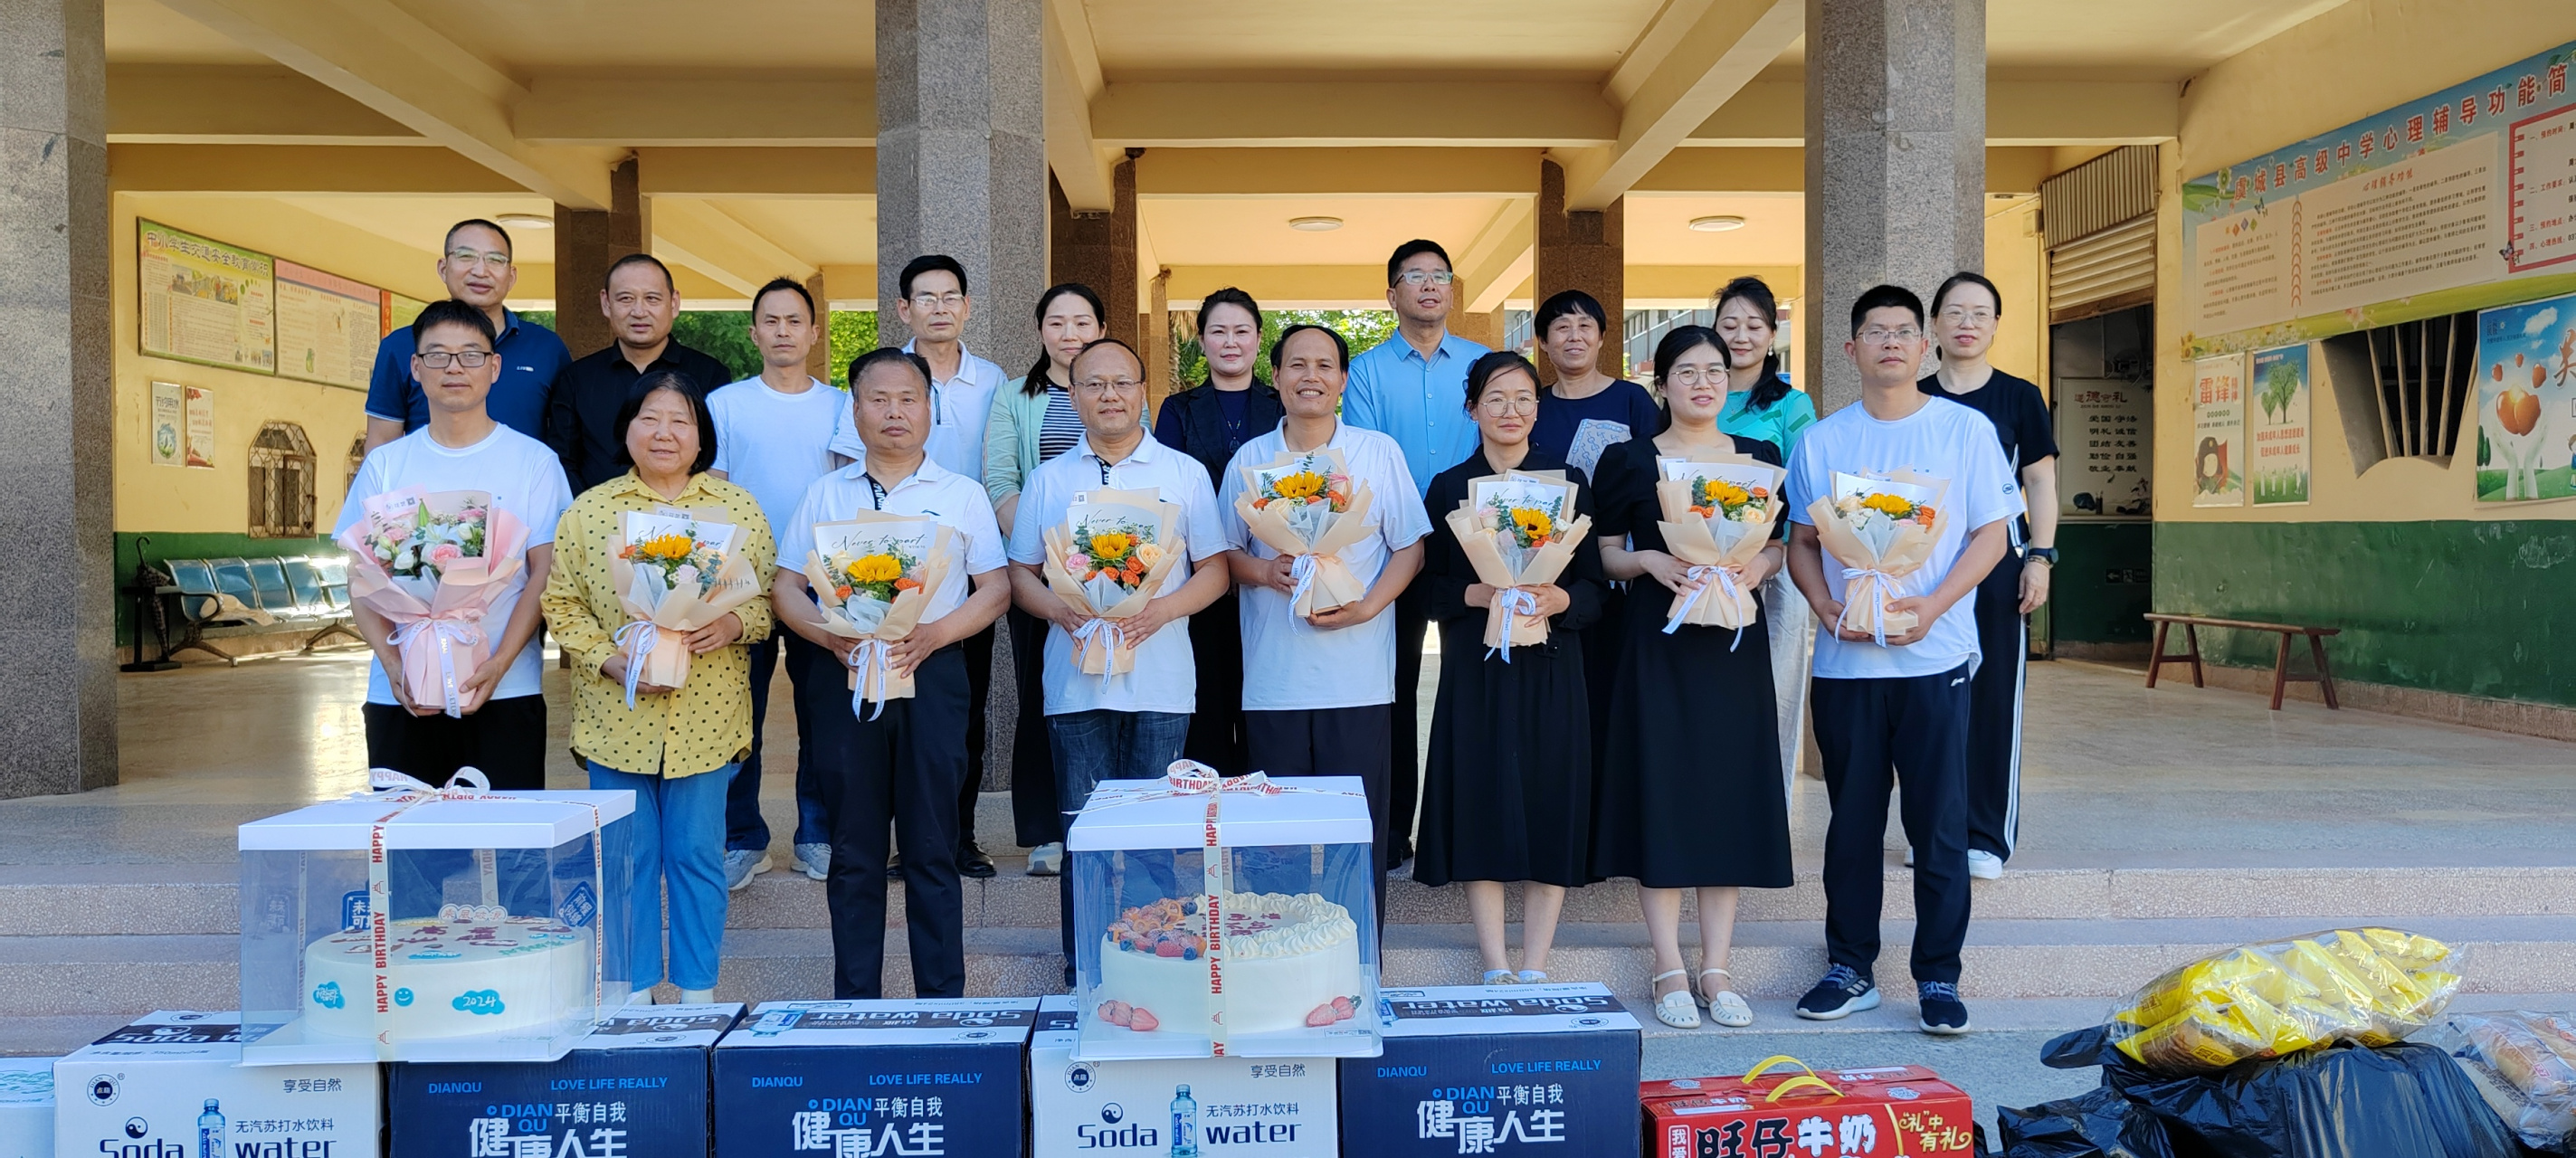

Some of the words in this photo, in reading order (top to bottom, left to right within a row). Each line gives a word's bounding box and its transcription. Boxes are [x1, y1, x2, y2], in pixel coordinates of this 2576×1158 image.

[2074, 390, 2128, 403] 道德守礼
[2200, 375, 2229, 403] 雷锋
[2088, 427, 2111, 435] 明礼
[2115, 427, 2137, 435] 诚信
[2088, 440, 2111, 448] 团结
[2115, 452, 2137, 460] 自强
[832, 530, 873, 551] Never
[372, 824, 385, 864] HAPPY
[1208, 894, 1221, 951] BIRTHDAY
[374, 911, 388, 969] BIRTHDAY
[1211, 956, 1222, 994] HAPPY
[376, 973, 389, 1013] HAPPY
[462, 995, 497, 1008] 2024
[1516, 996, 1609, 1006] Soda
[628, 1015, 720, 1026] Soda
[809, 1011, 925, 1020] water
[930, 1010, 1022, 1020] Soda
[106, 1032, 211, 1043] Soda
[1250, 1064, 1307, 1078] 享受自然
[1376, 1066, 1428, 1078] DIANQU
[1491, 1062, 1526, 1075] LOVE
[1527, 1061, 1553, 1073] LIFE
[1554, 1058, 1602, 1072] REALLY
[282, 1077, 342, 1094] 享受自然
[550, 1079, 585, 1091] LOVE
[589, 1077, 615, 1090] LIFE
[618, 1077, 668, 1089] REALLY
[751, 1076, 803, 1088] DIANQU
[869, 1074, 903, 1087] LOVE
[906, 1073, 931, 1086] LIFE
[934, 1072, 983, 1085] REALLY
[428, 1082, 482, 1094] DIANQU
[1446, 1087, 1494, 1100] DIAN
[1497, 1084, 1564, 1106] 平衡自我
[501, 1103, 554, 1118] DIAN
[822, 1097, 872, 1112] DIAN
[874, 1096, 943, 1119] 平衡自我
[1205, 1103, 1299, 1118] 无汽苏打水饮料
[1462, 1101, 1490, 1115] QU
[555, 1102, 627, 1125] 平衡自我
[839, 1113, 867, 1126] QU
[234, 1116, 335, 1134] 无汽苏打水饮料
[518, 1118, 547, 1133] QU
[1416, 1099, 1565, 1154] 健康人生
[469, 1117, 628, 1158] 健康人生
[792, 1111, 945, 1158] 健康人生
[1077, 1123, 1158, 1149] Soda
[1205, 1121, 1302, 1145] water
[1697, 1114, 1877, 1158] 旺仔牛奶
[1920, 1127, 1973, 1153] 有礼
[100, 1138, 185, 1158] Soda
[234, 1135, 337, 1158] water
